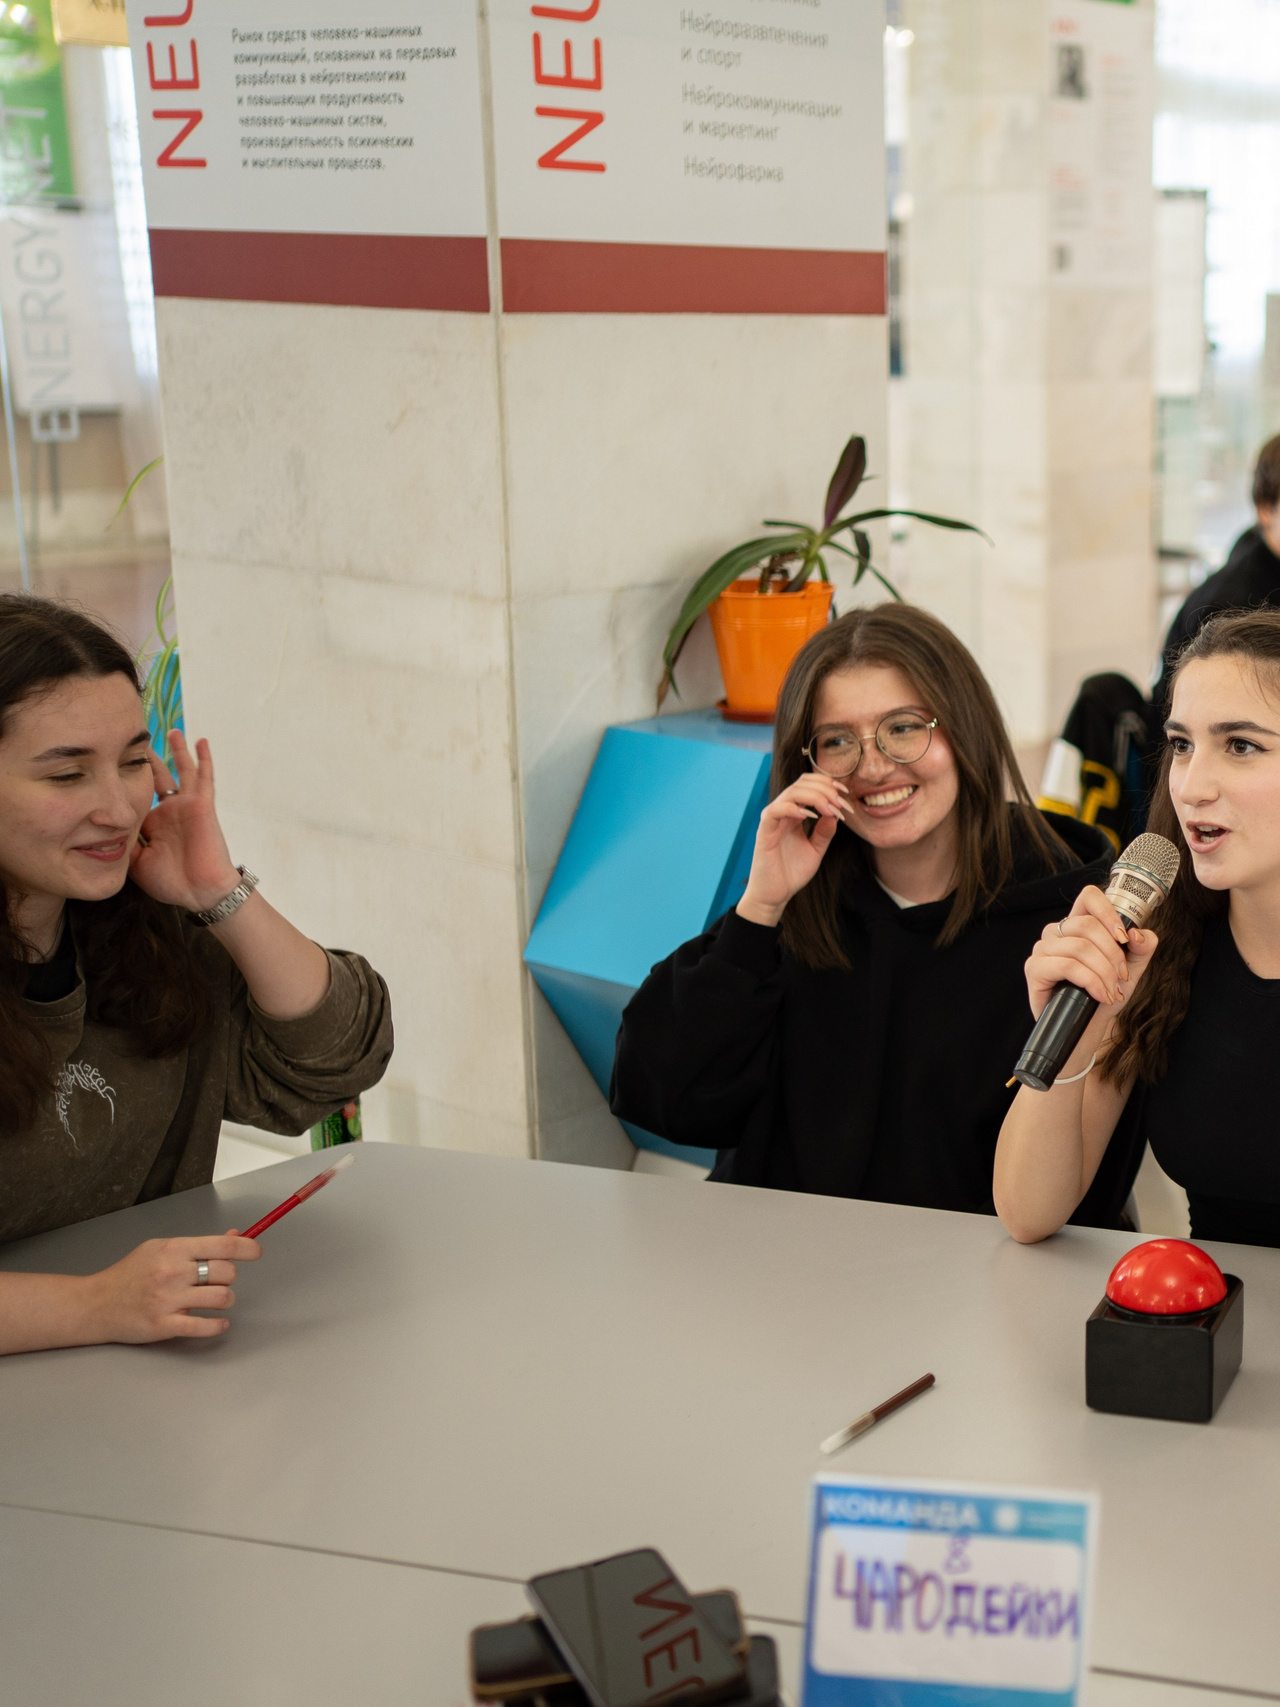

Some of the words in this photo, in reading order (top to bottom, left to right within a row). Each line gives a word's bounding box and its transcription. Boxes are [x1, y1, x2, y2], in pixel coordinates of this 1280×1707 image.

[232, 28, 263, 42] Рынок
[267, 29, 307, 44] средств
[310, 25, 422, 41] человеко-машинных
[234, 47, 310, 66] коммуникаций,
[314, 50, 375, 63] основанных
[380, 49, 392, 60] на
[396, 46, 456, 62] передовых
[697, 47, 743, 70] спорт
[235, 71, 296, 88] разработках
[300, 75, 306, 84] в
[310, 69, 406, 86] нейротехнологиях
[237, 97, 243, 106] и
[247, 94, 316, 108] повышающих
[320, 92, 404, 108] продуктивность
[239, 115, 344, 127] человеко-машинных
[348, 115, 387, 128] систем,
[699, 121, 779, 141] маркетинг
[241, 136, 344, 150] производительность
[348, 136, 414, 149] психических
[242, 159, 248, 168] и
[252, 158, 324, 169] мыслительных
[328, 158, 385, 171] процессов.
[834, 1552, 1081, 1641] ЧАРОДЕЙКИ
